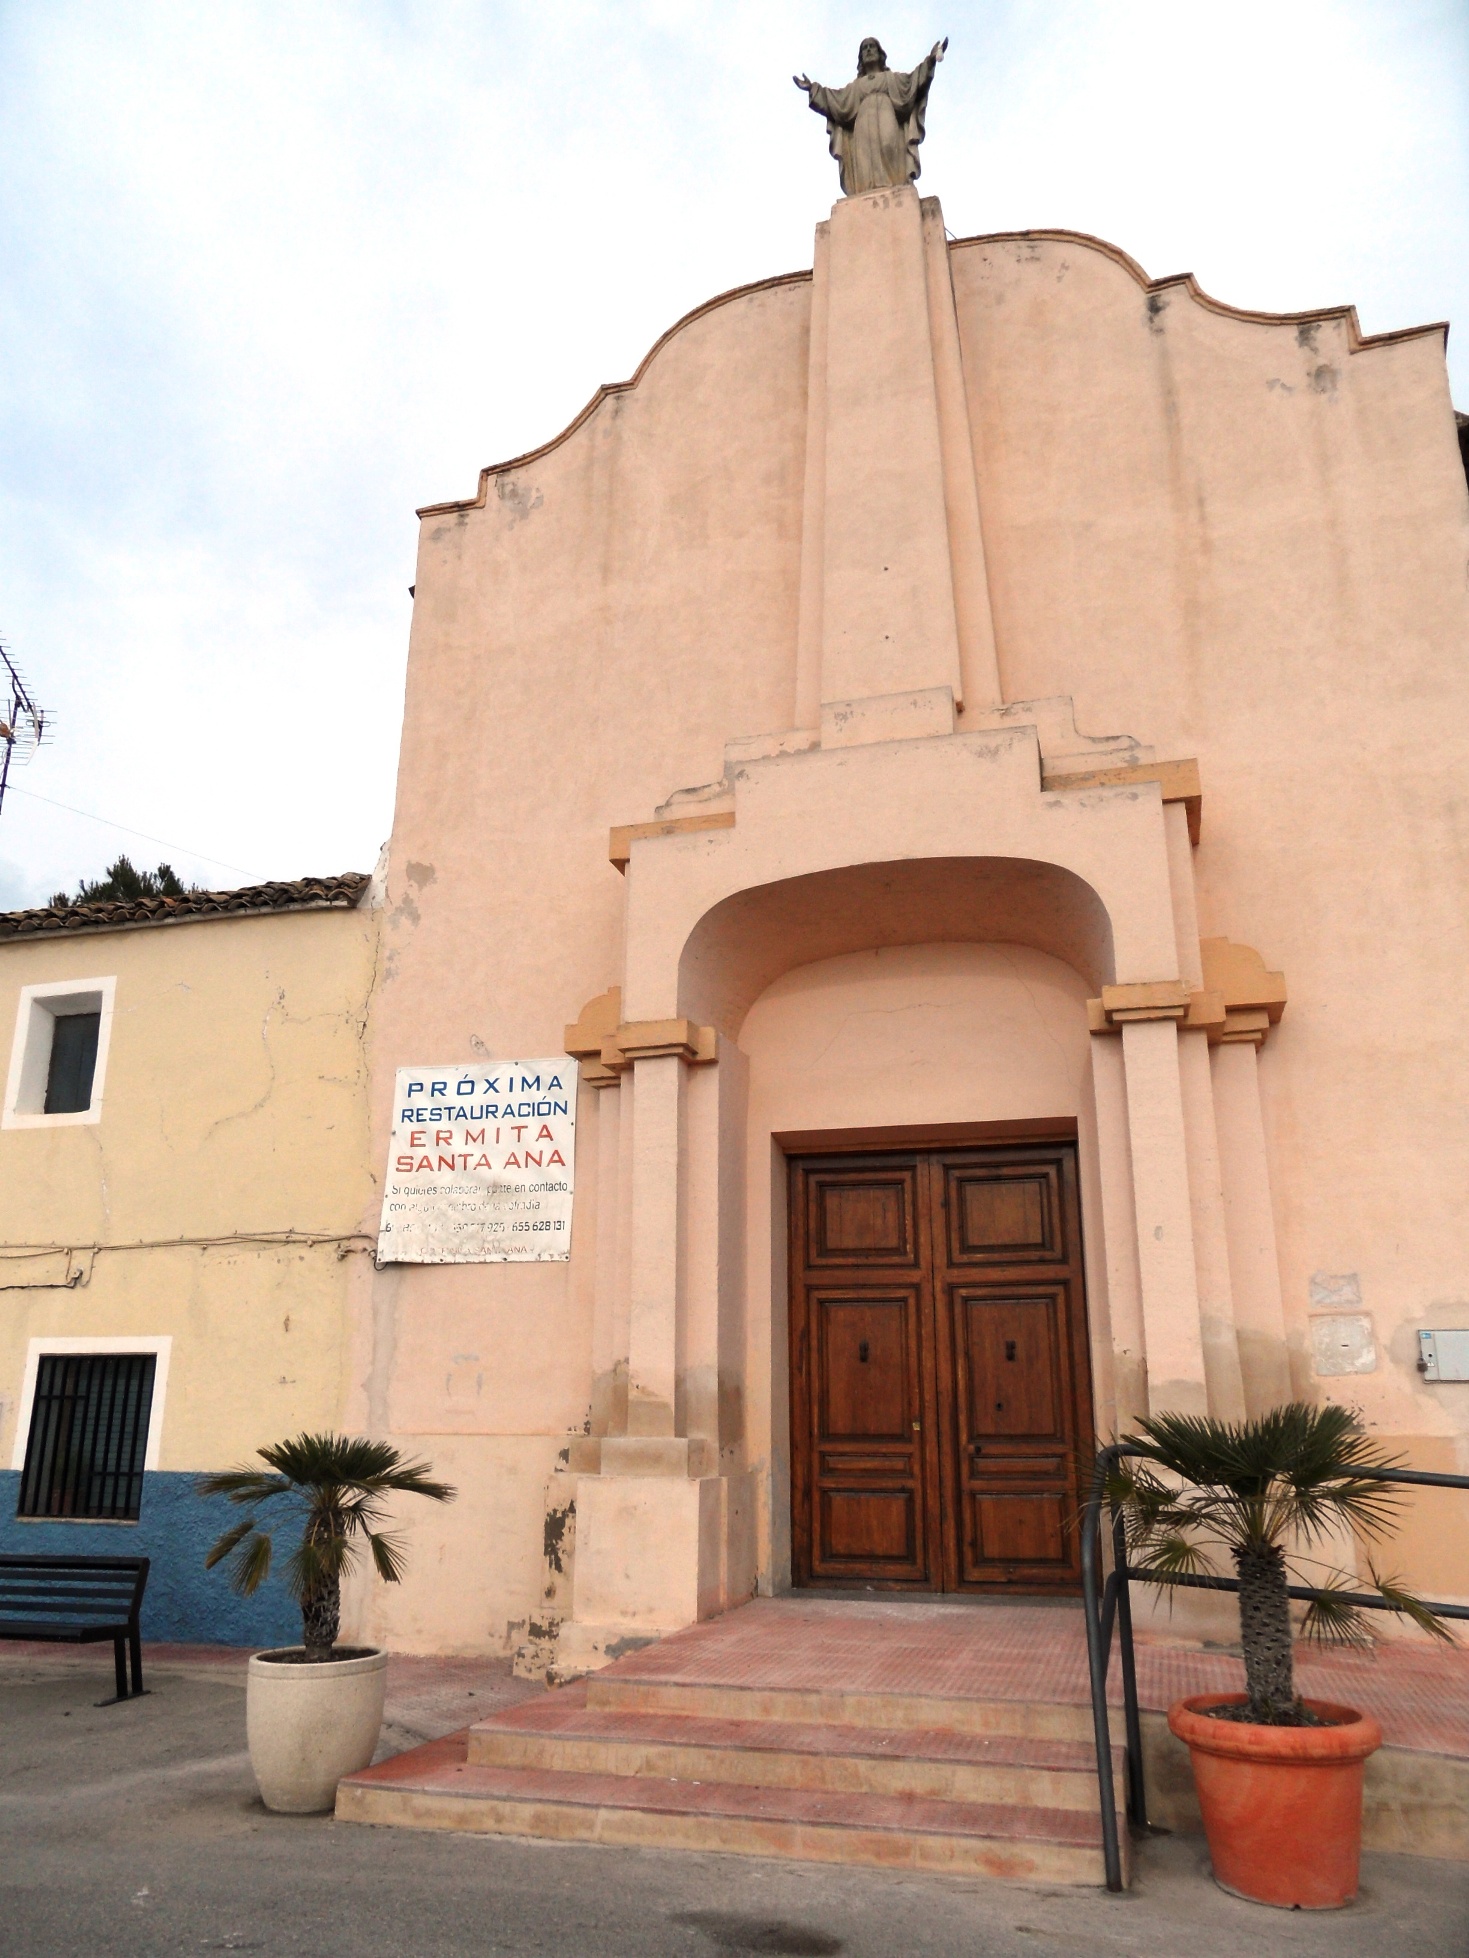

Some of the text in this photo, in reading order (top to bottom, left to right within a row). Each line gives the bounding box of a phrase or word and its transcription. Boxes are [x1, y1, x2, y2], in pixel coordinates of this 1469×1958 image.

[407, 1073, 564, 1098] PRÓXIMA
[401, 1096, 568, 1123] RESTAURACIÓN
[410, 1124, 554, 1148] ERMITA
[395, 1149, 566, 1173] SANTA ANA
[514, 1183, 526, 1193] en
[528, 1180, 568, 1192] contacto
[511, 1221, 531, 1232] 655
[532, 1220, 551, 1232] 628
[553, 1220, 566, 1231] 131
